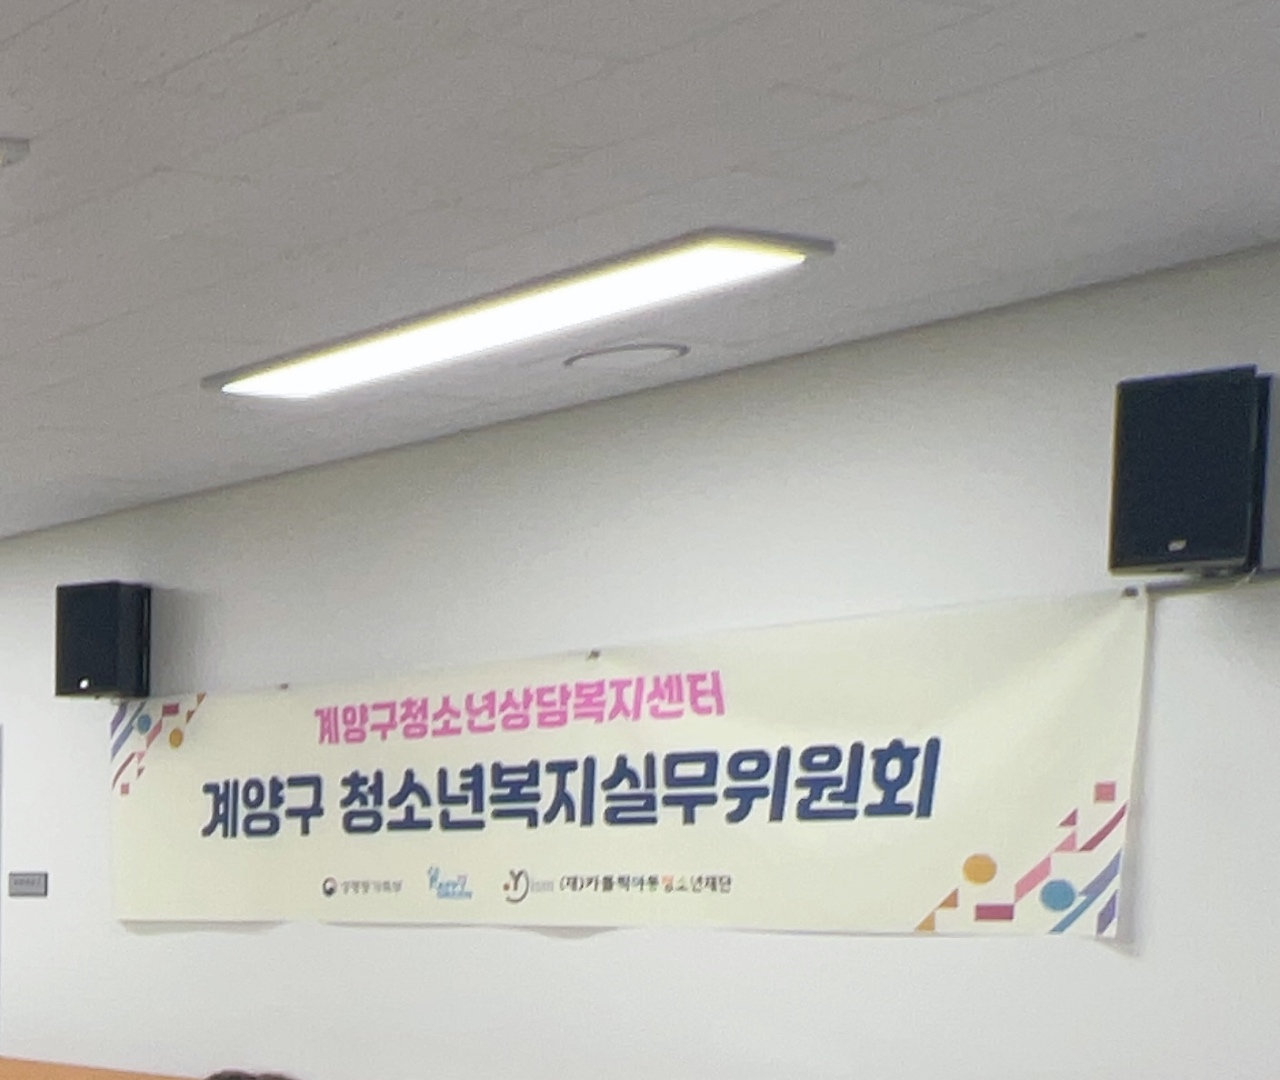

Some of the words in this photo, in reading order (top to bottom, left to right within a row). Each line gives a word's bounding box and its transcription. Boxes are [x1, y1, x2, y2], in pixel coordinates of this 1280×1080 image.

[314, 669, 725, 745] 계양구청소년상담복지센터
[201, 774, 325, 839] 계양구
[339, 736, 942, 834] 청소년복지실무위원회
